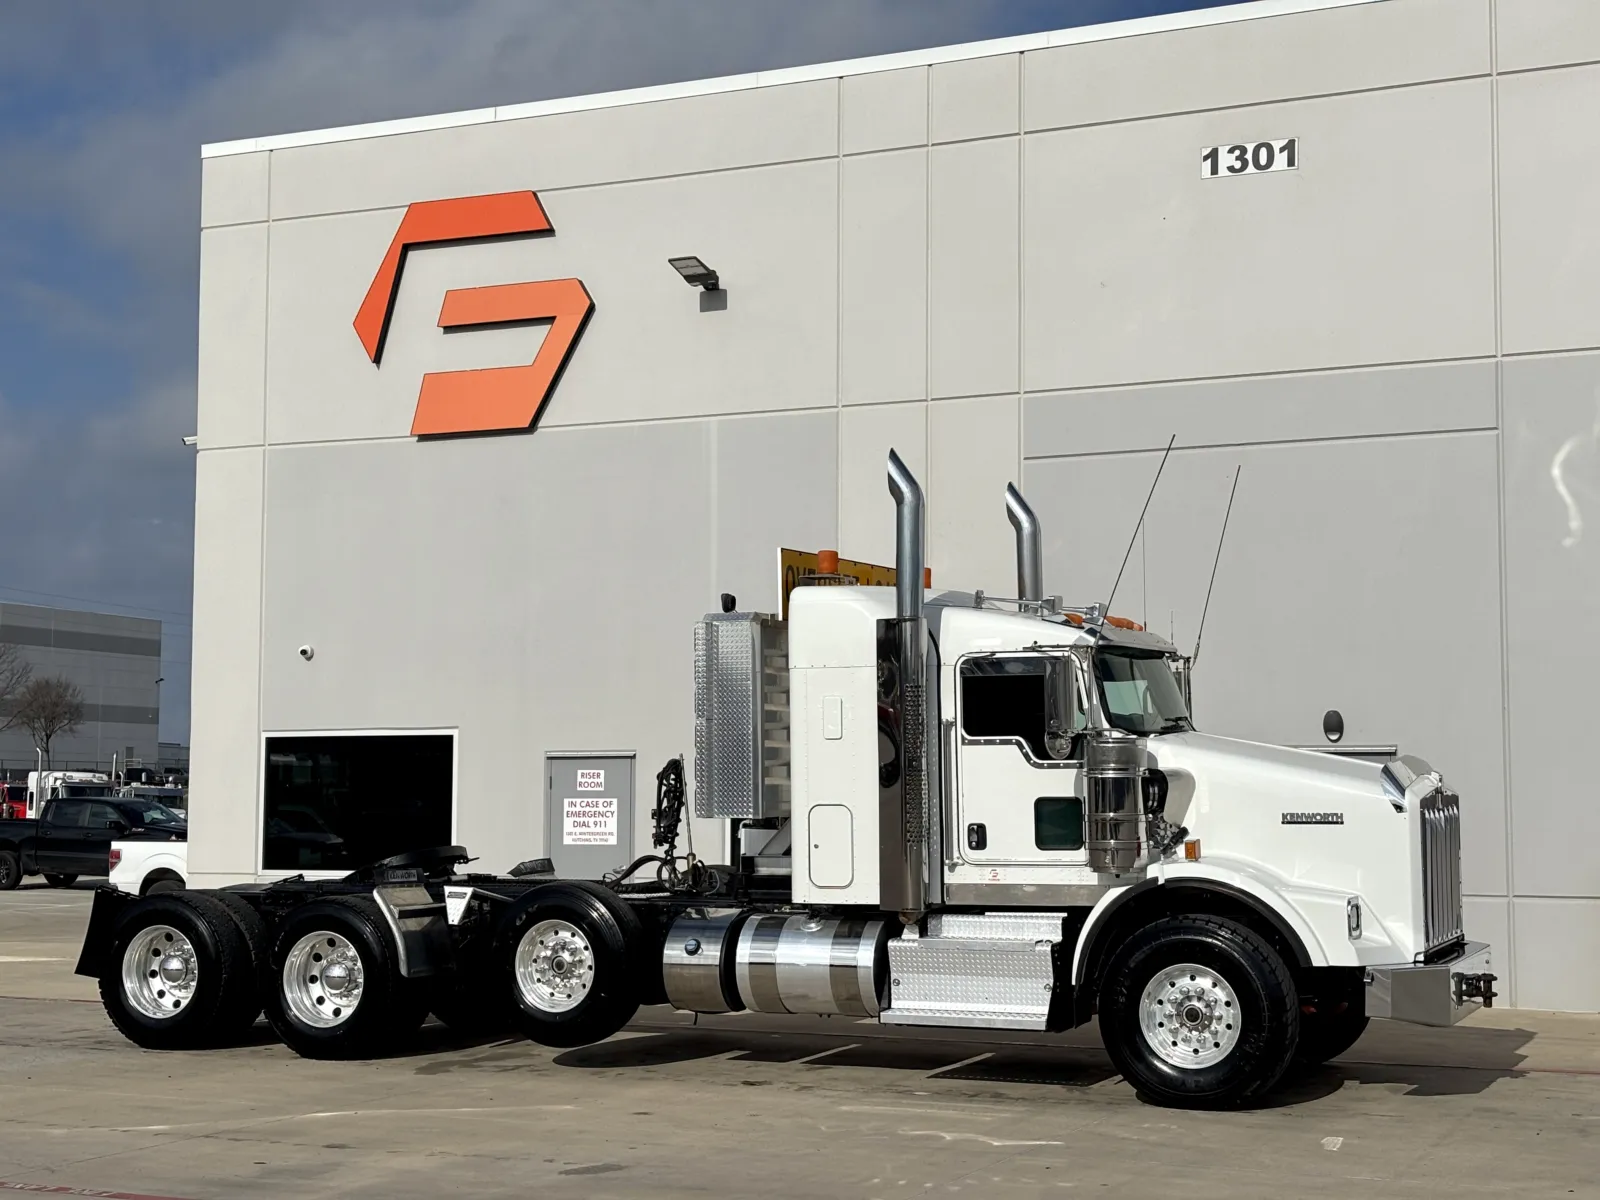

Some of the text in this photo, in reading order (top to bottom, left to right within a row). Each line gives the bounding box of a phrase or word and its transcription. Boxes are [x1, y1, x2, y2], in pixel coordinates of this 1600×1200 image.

[1202, 138, 1296, 176] 1301
[568, 800, 614, 808] IN CASE OF
[566, 810, 615, 818] EMERGENCY
[1281, 812, 1343, 822] KENWORTH
[573, 820, 607, 828] DIAL 911
